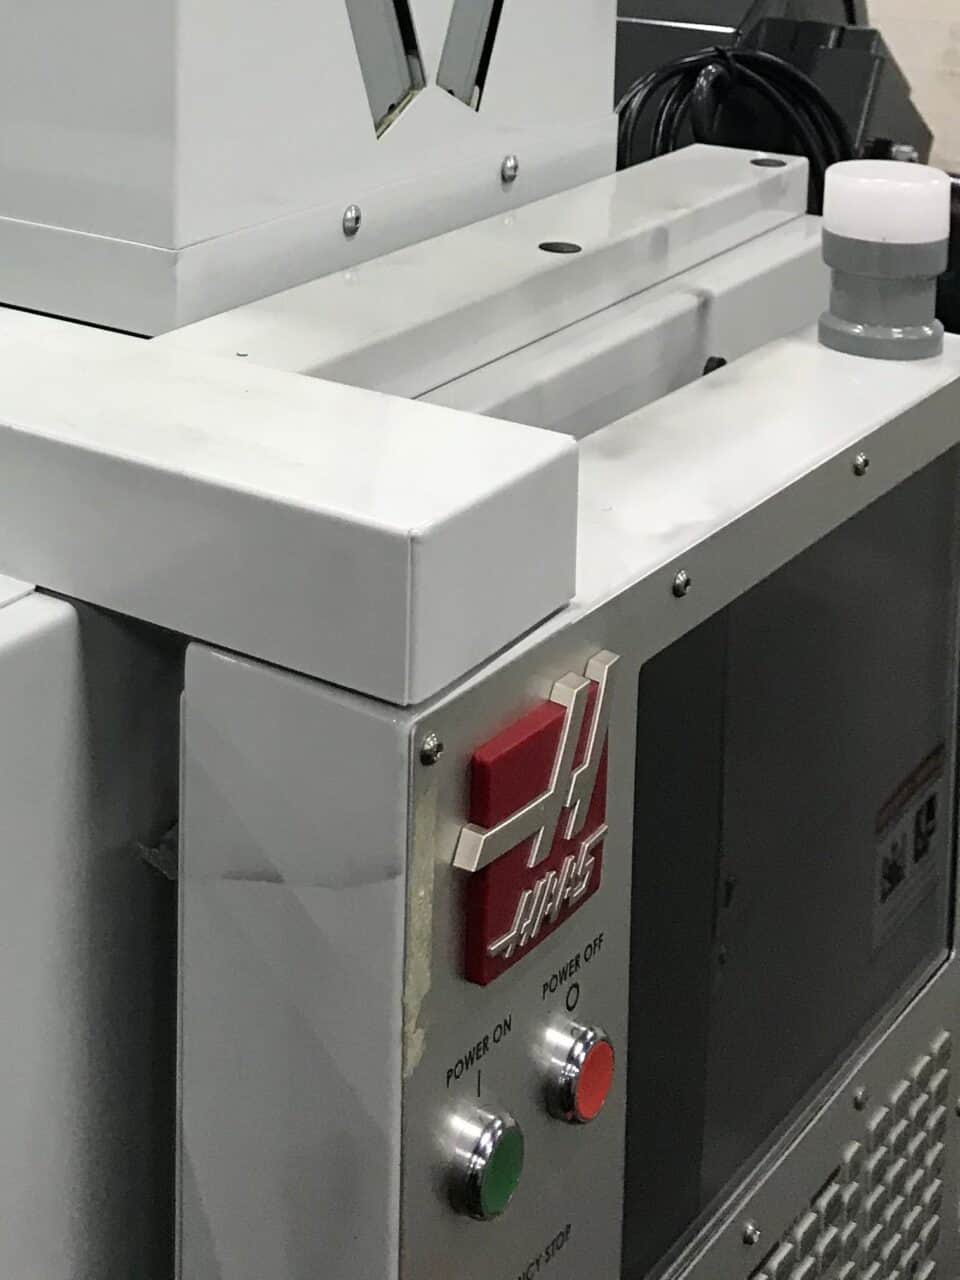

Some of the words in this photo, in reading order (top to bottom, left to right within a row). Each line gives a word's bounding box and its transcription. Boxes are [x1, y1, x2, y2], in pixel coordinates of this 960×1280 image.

[487, 823, 608, 959] HAAS
[542, 953, 581, 1001] POWER
[583, 933, 604, 962] OFF
[446, 1035, 489, 1089] POWER
[493, 1014, 512, 1044] ON
[544, 1224, 571, 1264] STOP
